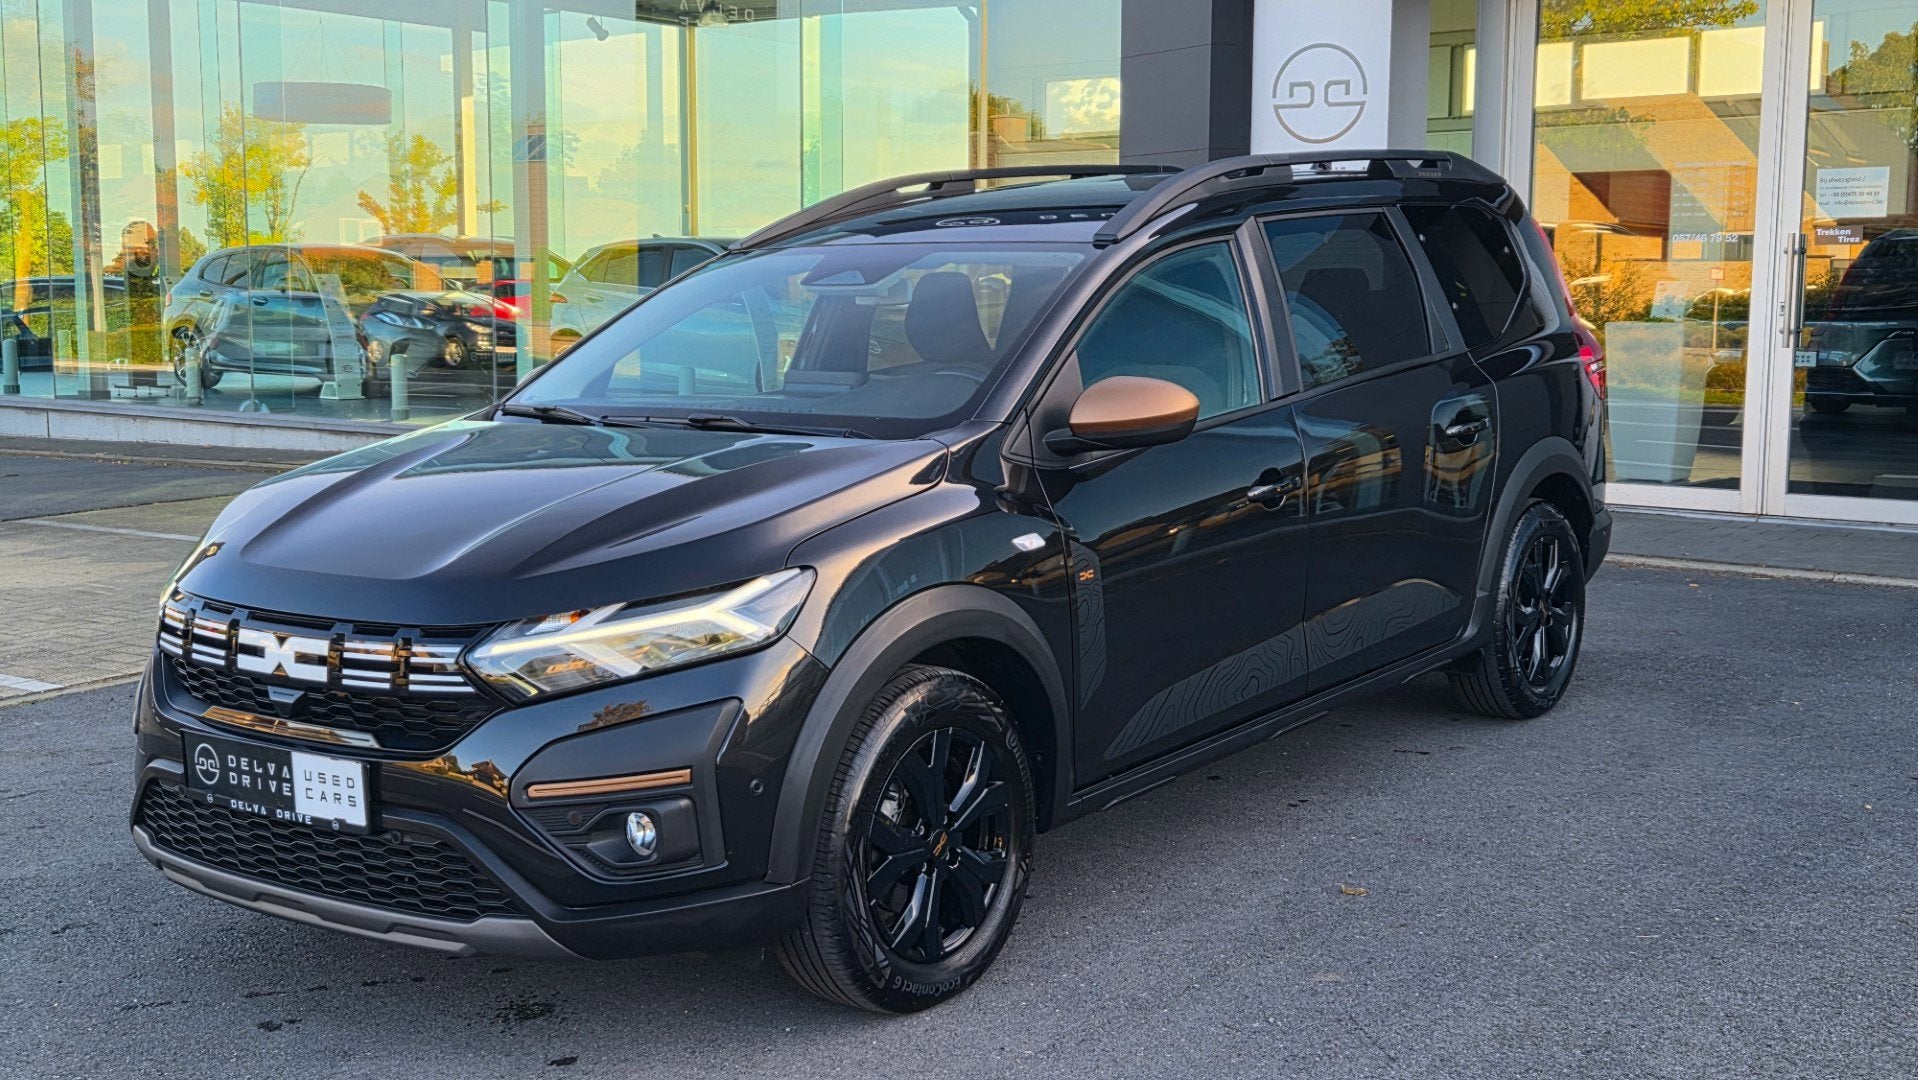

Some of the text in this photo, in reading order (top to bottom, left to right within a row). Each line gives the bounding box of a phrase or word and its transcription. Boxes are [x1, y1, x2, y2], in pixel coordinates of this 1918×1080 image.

[1672, 233, 1739, 243] 057/46 79 52
[1816, 228, 1851, 236] Trekken
[227, 754, 292, 779] DELVA
[229, 772, 292, 796] DRIVE
[304, 769, 355, 789] USED
[305, 787, 357, 807] CARS
[231, 799, 312, 825] DELVA DRIVE
